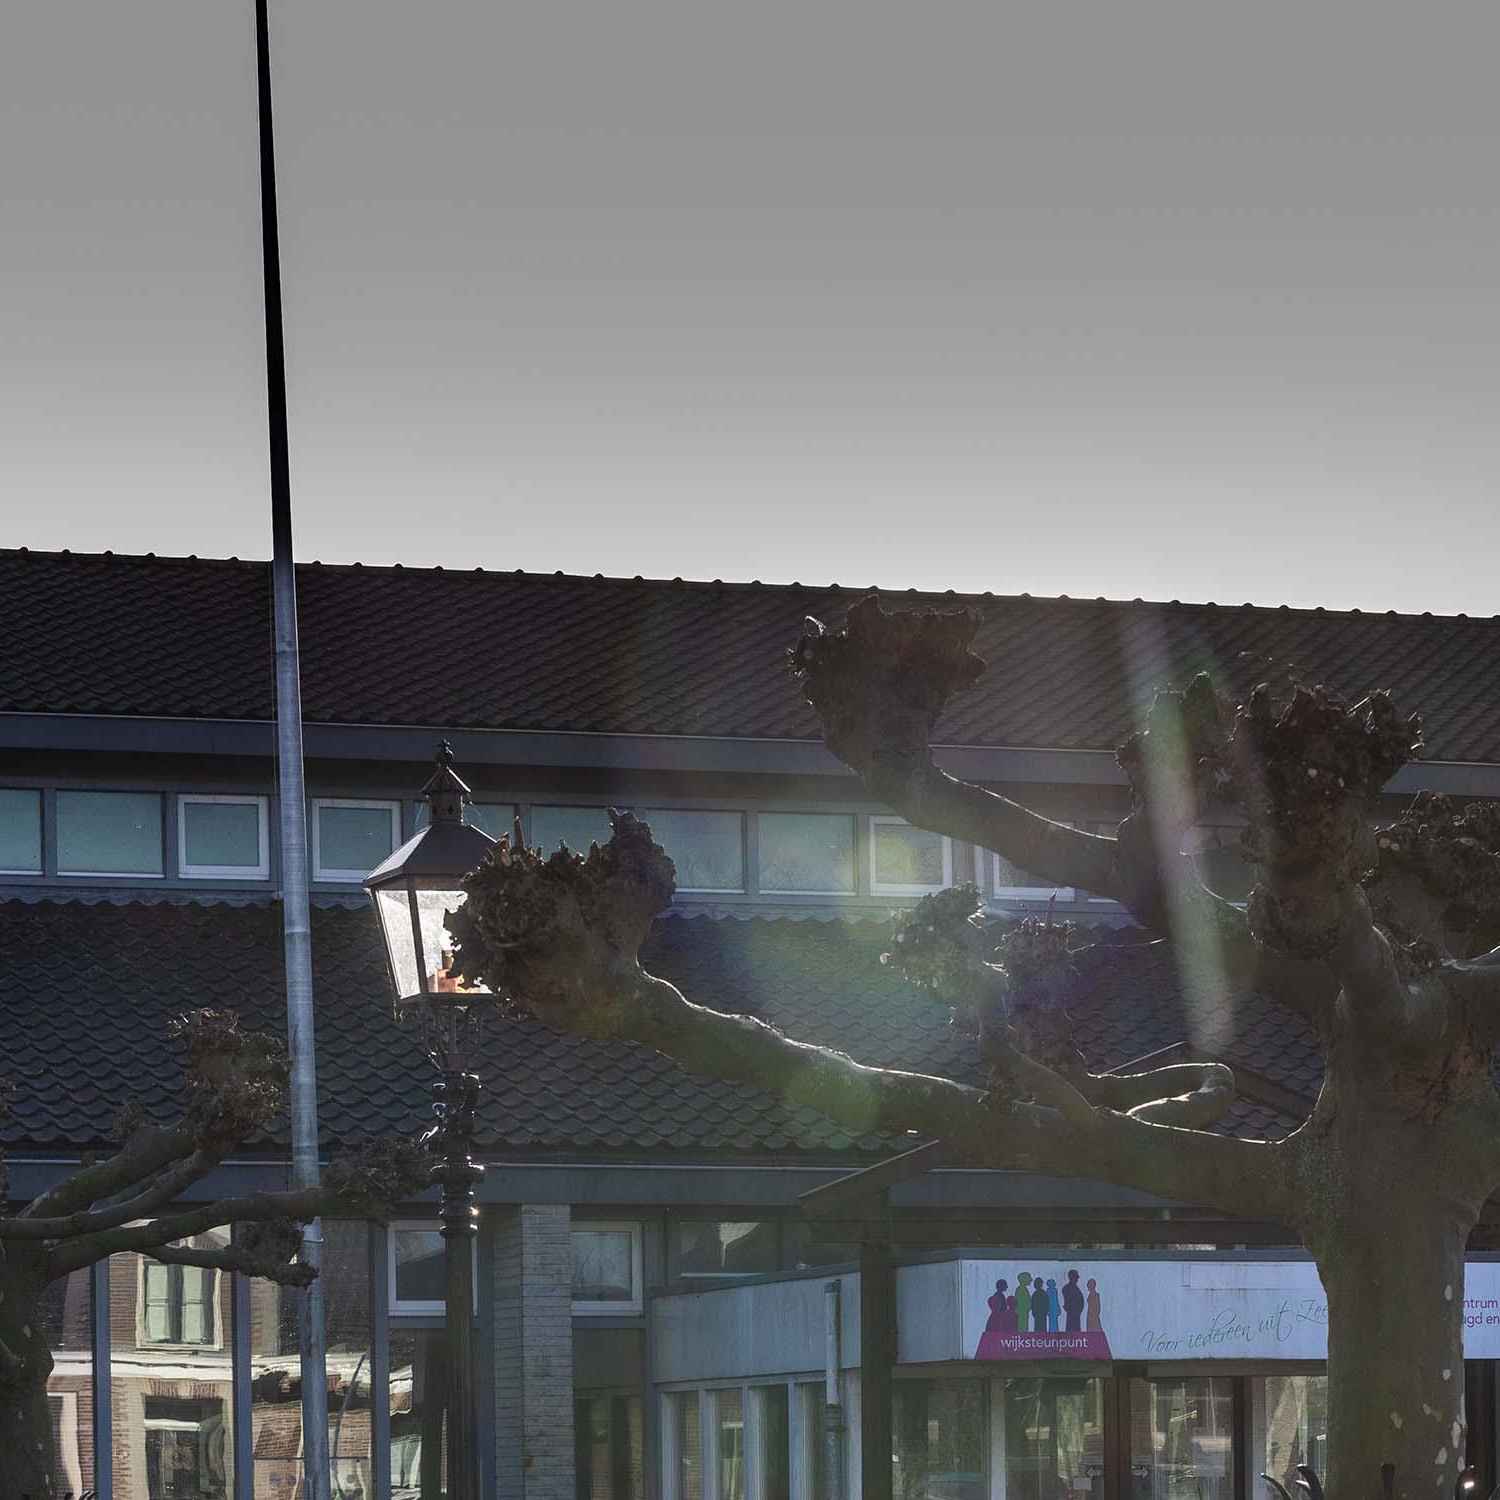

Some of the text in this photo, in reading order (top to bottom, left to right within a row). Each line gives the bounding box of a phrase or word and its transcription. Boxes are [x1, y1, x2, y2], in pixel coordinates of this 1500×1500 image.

[1140, 1330, 1183, 1353] Voor
[1188, 1308, 1254, 1349] iedereen
[1258, 1297, 1293, 1342] uit
[1485, 1315, 1500, 1325] en
[1000, 1335, 1088, 1352] wijksteunpunt
